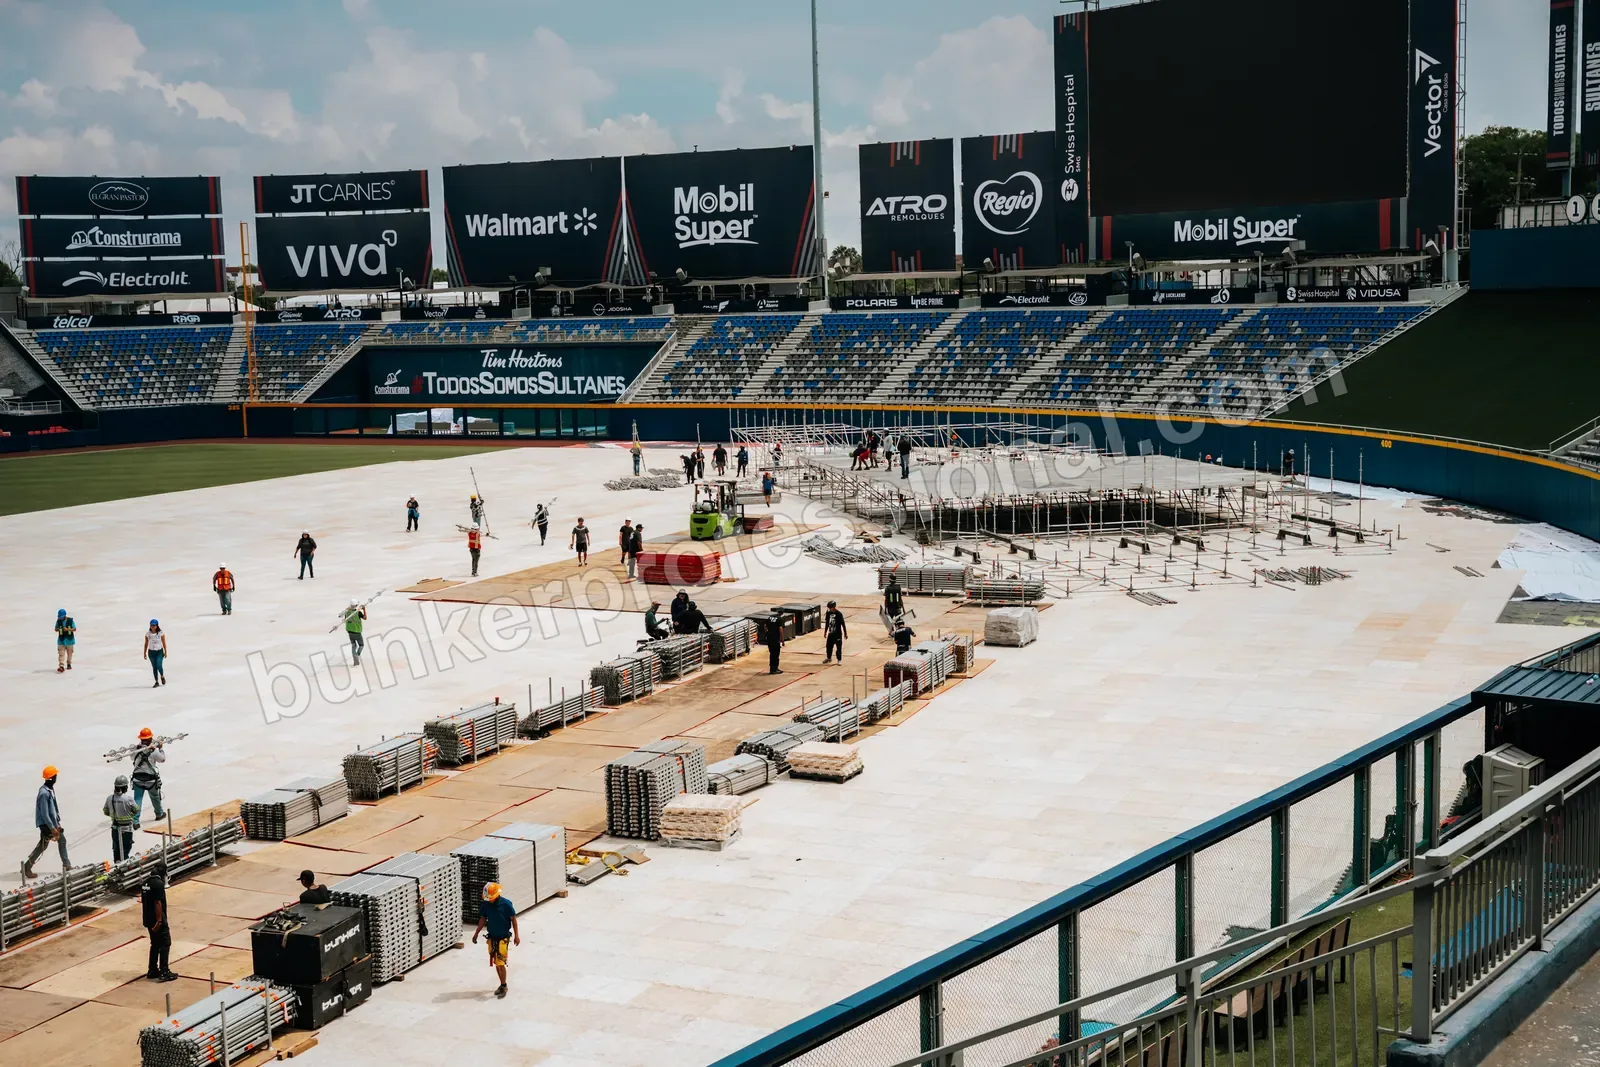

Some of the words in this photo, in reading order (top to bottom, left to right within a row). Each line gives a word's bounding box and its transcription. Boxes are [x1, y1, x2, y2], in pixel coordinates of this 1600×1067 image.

[1424, 74, 1442, 158] Vector
[100, 193, 119, 201] GRAN
[290, 184, 316, 204] JT
[318, 182, 392, 202] CARNES
[674, 183, 754, 215] Mobil
[865, 194, 947, 216] ATRO
[982, 190, 1034, 216] Regio
[1572, 201, 1580, 217] 1
[465, 211, 569, 238] Walmart
[891, 212, 945, 222] REMOLQUES
[674, 215, 754, 246] Super
[1174, 218, 1229, 242] Mobil
[1232, 215, 1298, 245] Super
[94, 230, 182, 247] Construrama
[109, 271, 190, 287] Electrolit
[1017, 295, 1050, 304] Electrolit
[1360, 288, 1402, 298] VIDUSA
[846, 298, 898, 308] POLARIS
[172, 314, 201, 323] RAGA
[323, 308, 362, 318] ATRO
[423, 309, 445, 318] Vector
[52, 315, 94, 329] telcel
[480, 349, 506, 368] Tim
[508, 348, 563, 368] Hortons
[374, 384, 410, 394] Construrama
[1380, 439, 1393, 449] 400
